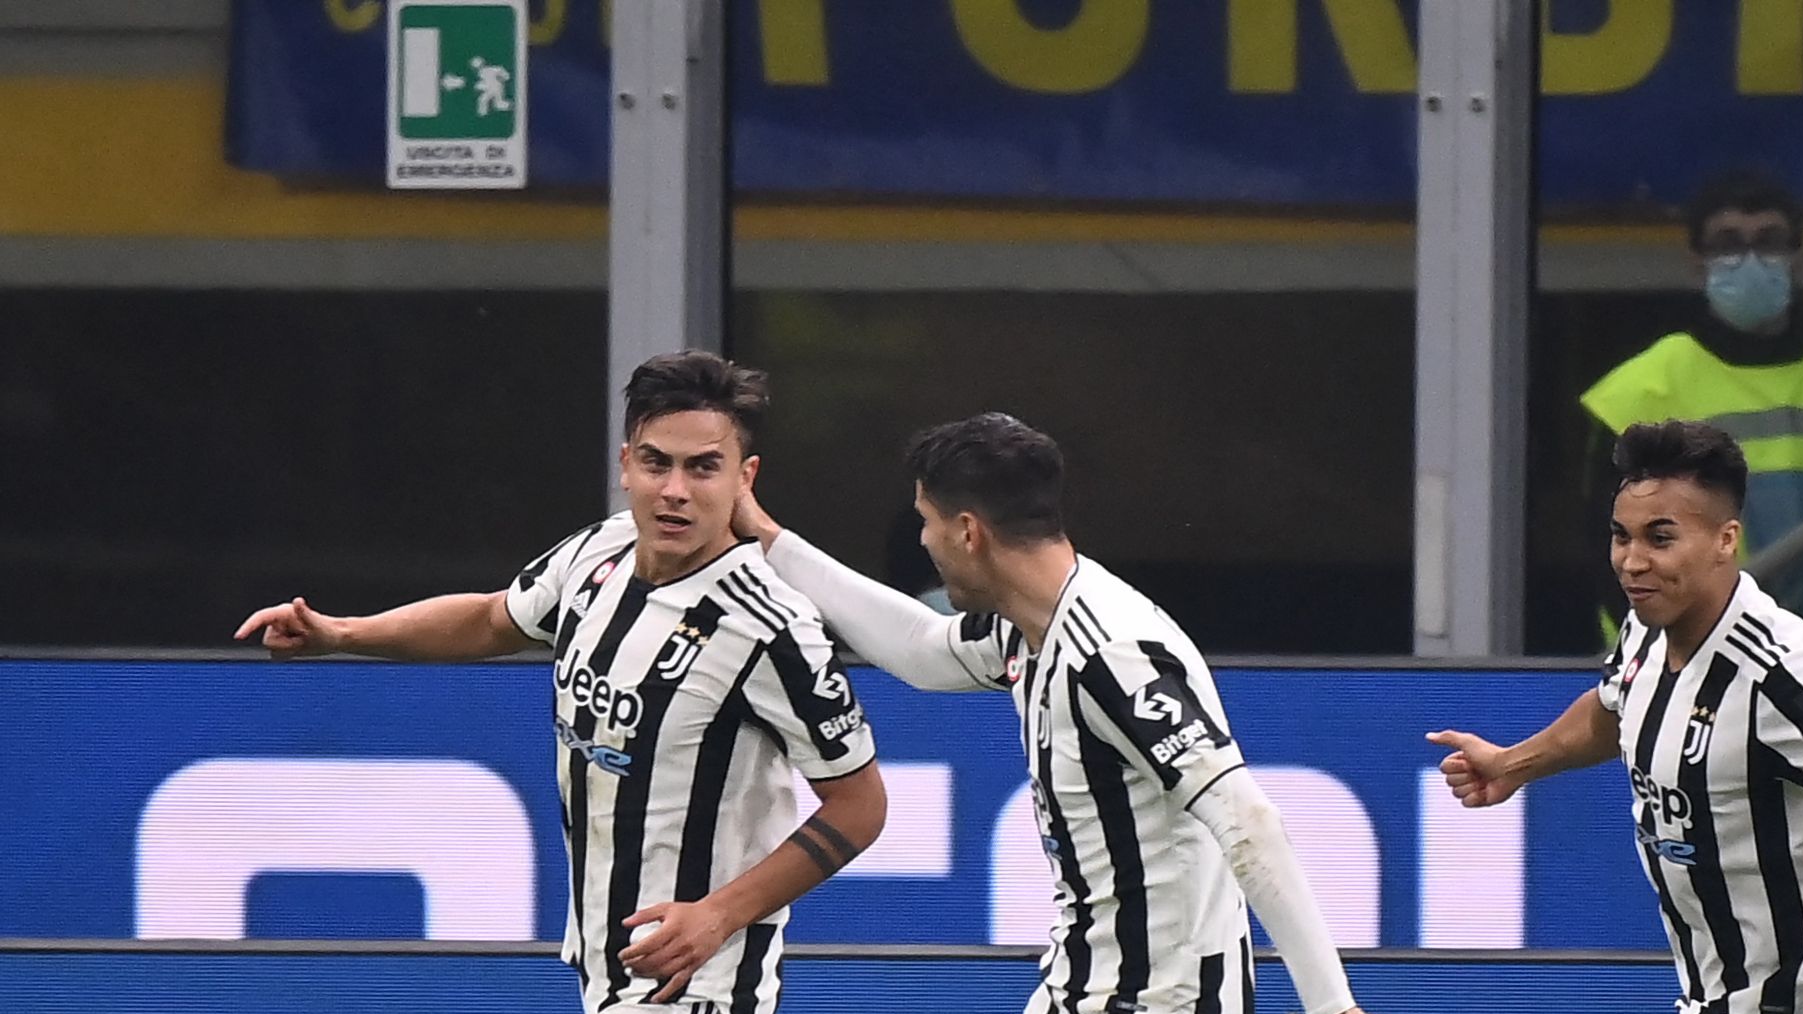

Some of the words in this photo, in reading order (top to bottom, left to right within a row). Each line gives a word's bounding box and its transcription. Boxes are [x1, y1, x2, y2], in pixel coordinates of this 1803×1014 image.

[554, 647, 644, 734] Jeep
[817, 702, 863, 741] Bitg
[1150, 718, 1208, 764] Bitget
[1624, 750, 1692, 826] eep
